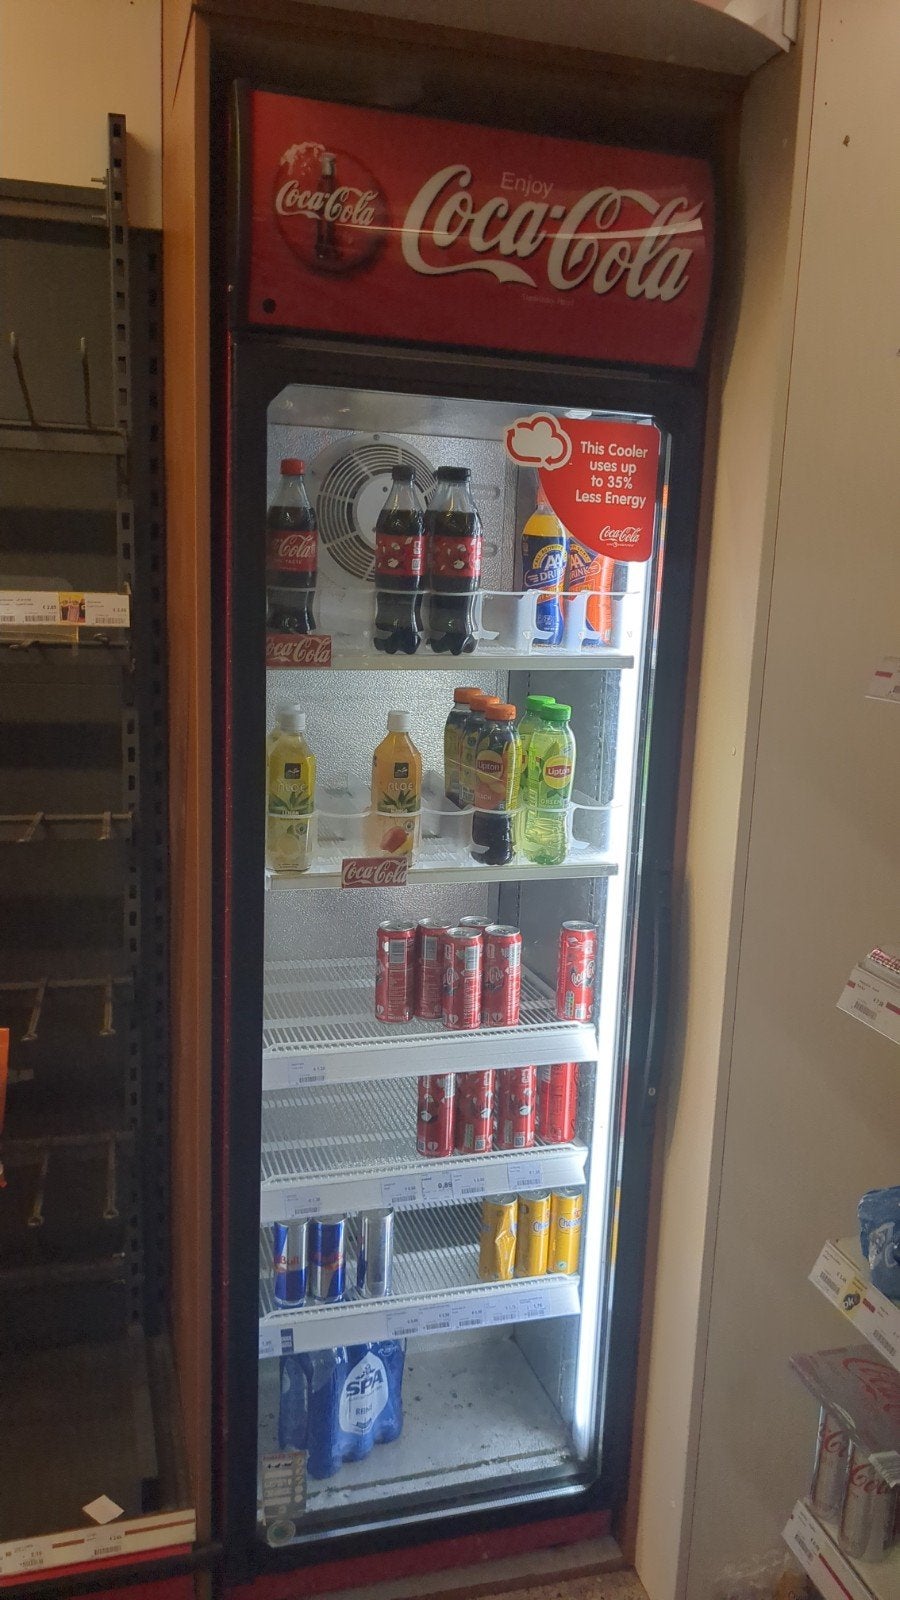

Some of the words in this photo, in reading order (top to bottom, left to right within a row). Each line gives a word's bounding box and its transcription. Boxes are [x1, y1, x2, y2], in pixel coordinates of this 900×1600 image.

[500, 171, 554, 199] Enjoy
[275, 180, 379, 226] Coca-Cola
[401, 163, 704, 301] Coca-Cola
[580, 441, 605, 454] This
[608, 443, 649, 459] Cooler
[589, 461, 617, 473] uses
[621, 463, 638, 476] up
[591, 474, 604, 487] to
[607, 475, 634, 490] 35%
[575, 489, 602, 504] Less
[605, 491, 647, 510] Energy
[599, 525, 643, 543] Coca-Cola
[266, 636, 331, 663] oca-Cola
[546, 766, 571, 778] Lipton
[341, 860, 408, 885] Coca-Cola
[345, 1368, 384, 1397] SPA
